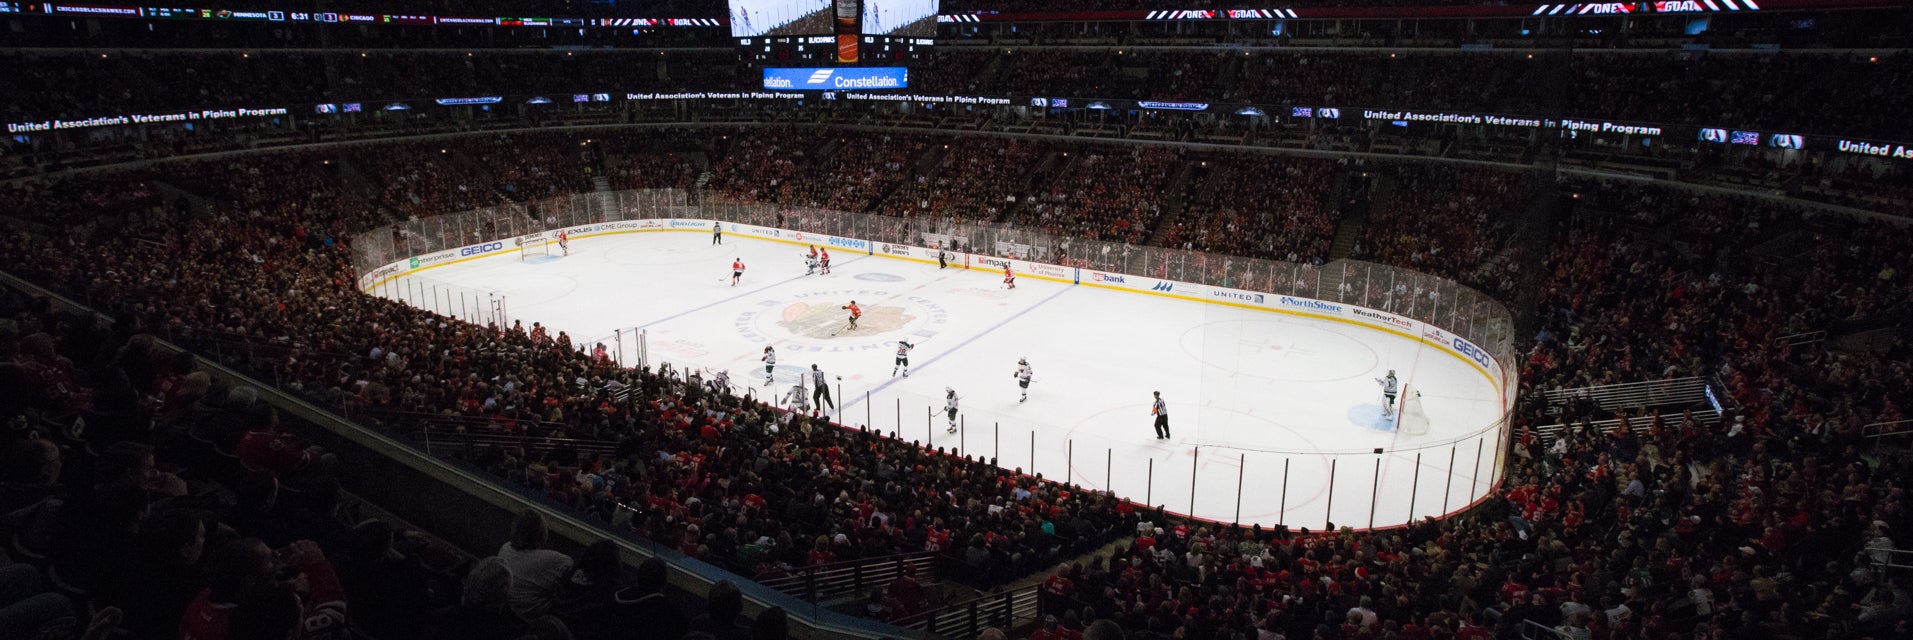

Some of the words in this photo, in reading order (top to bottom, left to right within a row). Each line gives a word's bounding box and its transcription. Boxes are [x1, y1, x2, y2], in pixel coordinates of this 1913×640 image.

[1187, 10, 1203, 19] ONE
[1594, 3, 1618, 14] ONE
[291, 12, 310, 20] 6:31
[835, 74, 897, 88] Constellation
[627, 92, 653, 100] United
[846, 92, 867, 100] United
[868, 93, 912, 101] Association's
[913, 94, 945, 103] Veterans
[945, 95, 953, 103] in
[954, 96, 977, 104] Piping
[978, 96, 1011, 105] Program
[8, 121, 51, 133] United
[53, 115, 129, 129] Association's
[132, 113, 187, 124] Veterans
[188, 111, 200, 120] in
[202, 109, 237, 119] Piping
[238, 107, 287, 117] Program
[1363, 110, 1402, 120] United
[1404, 111, 1481, 124] Association's
[1485, 115, 1541, 127] Veterans
[1544, 118, 1557, 128] in
[1561, 119, 1600, 132] Piping
[1602, 122, 1662, 136] Program
[1838, 140, 1890, 157] United
[752, 228, 774, 236] UNITED
[461, 241, 503, 257] GEICO
[793, 289, 889, 298] UNITED
[1213, 290, 1253, 301] UNITED
[907, 296, 948, 325] CENTER
[1287, 296, 1343, 313] NorthShore
[1353, 307, 1413, 329] WeatherTech
[1452, 337, 1490, 369] GEICO
